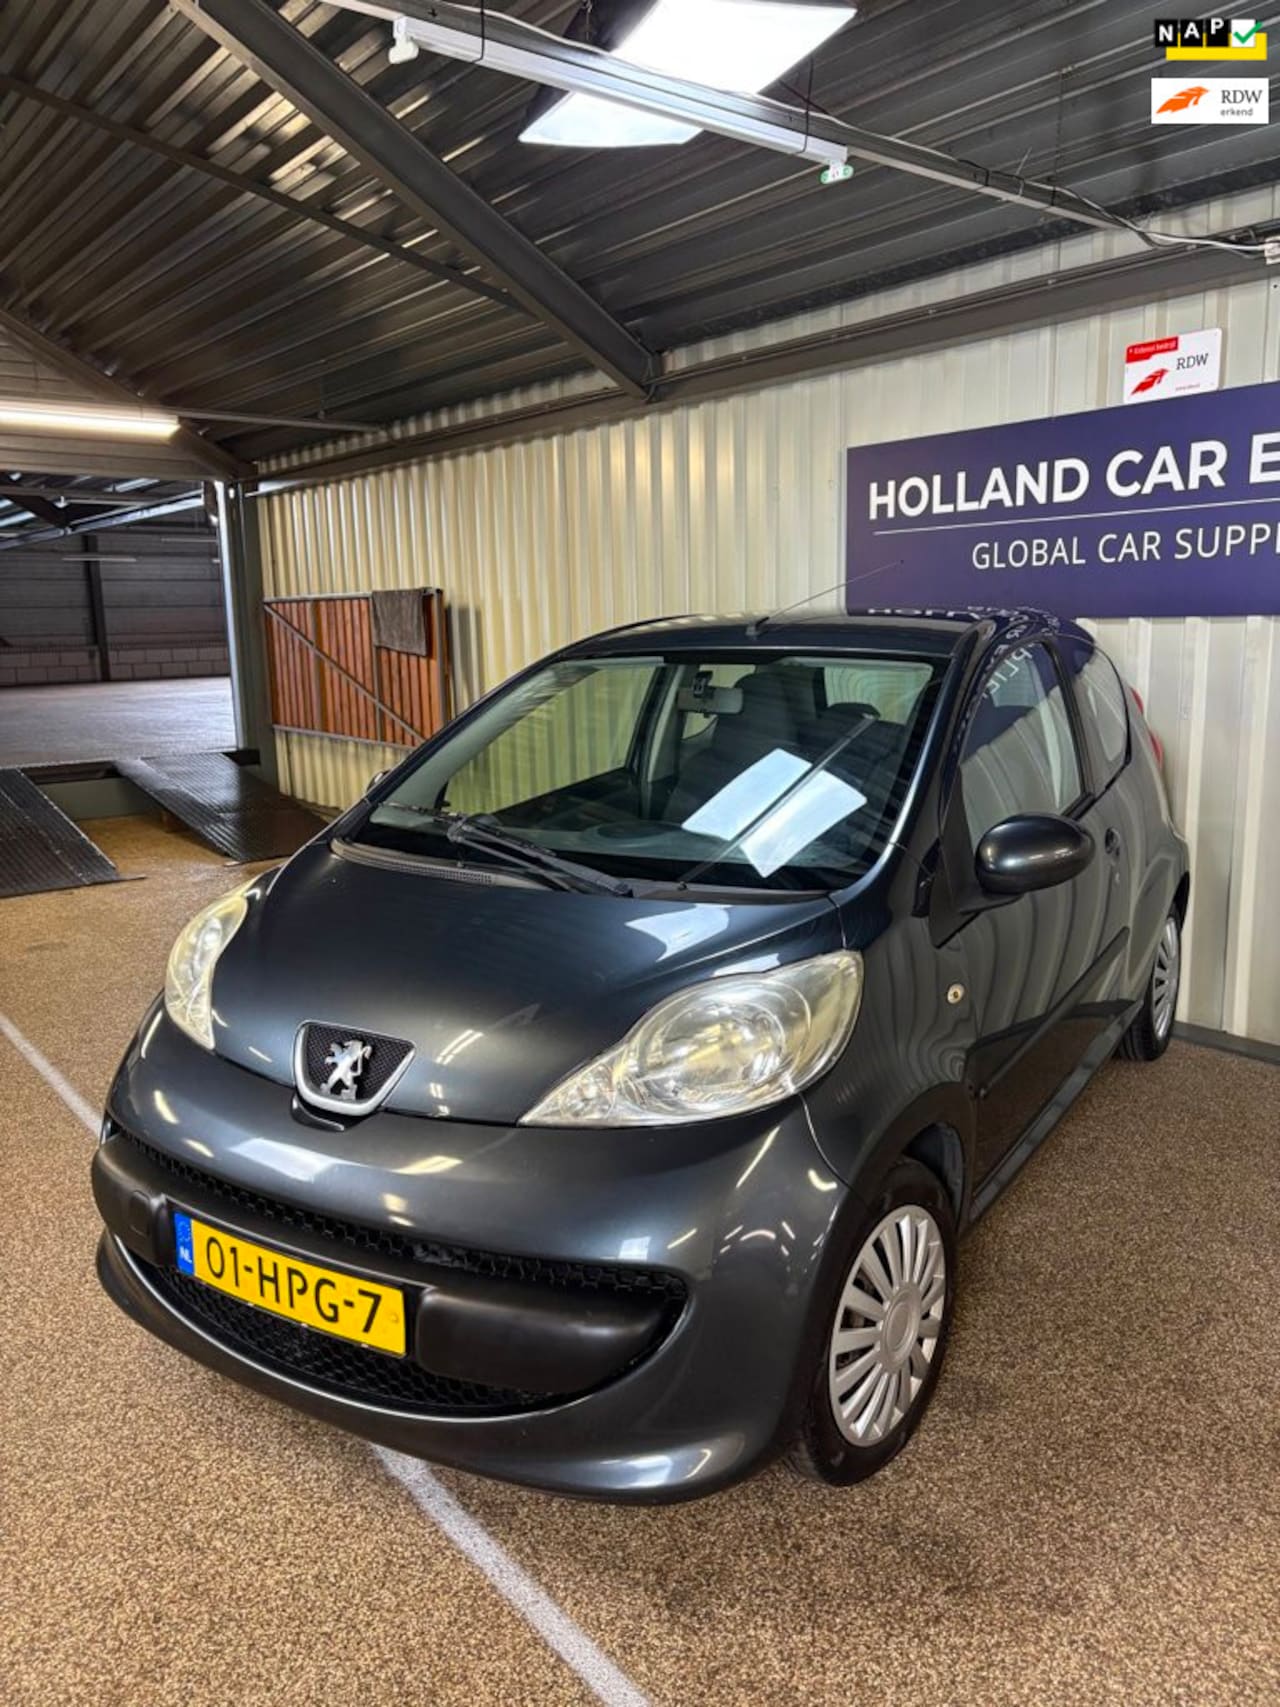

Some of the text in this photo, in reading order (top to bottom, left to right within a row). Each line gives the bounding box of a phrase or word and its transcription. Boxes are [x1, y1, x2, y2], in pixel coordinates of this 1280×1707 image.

[1175, 352, 1209, 371] RDW
[868, 431, 1280, 520] HOLLAND CAR E
[972, 536, 1086, 570] GLOBAL
[1098, 531, 1161, 563] CAR
[179, 1245, 193, 1264] NL
[205, 1236, 382, 1334] 01-HPG-7
